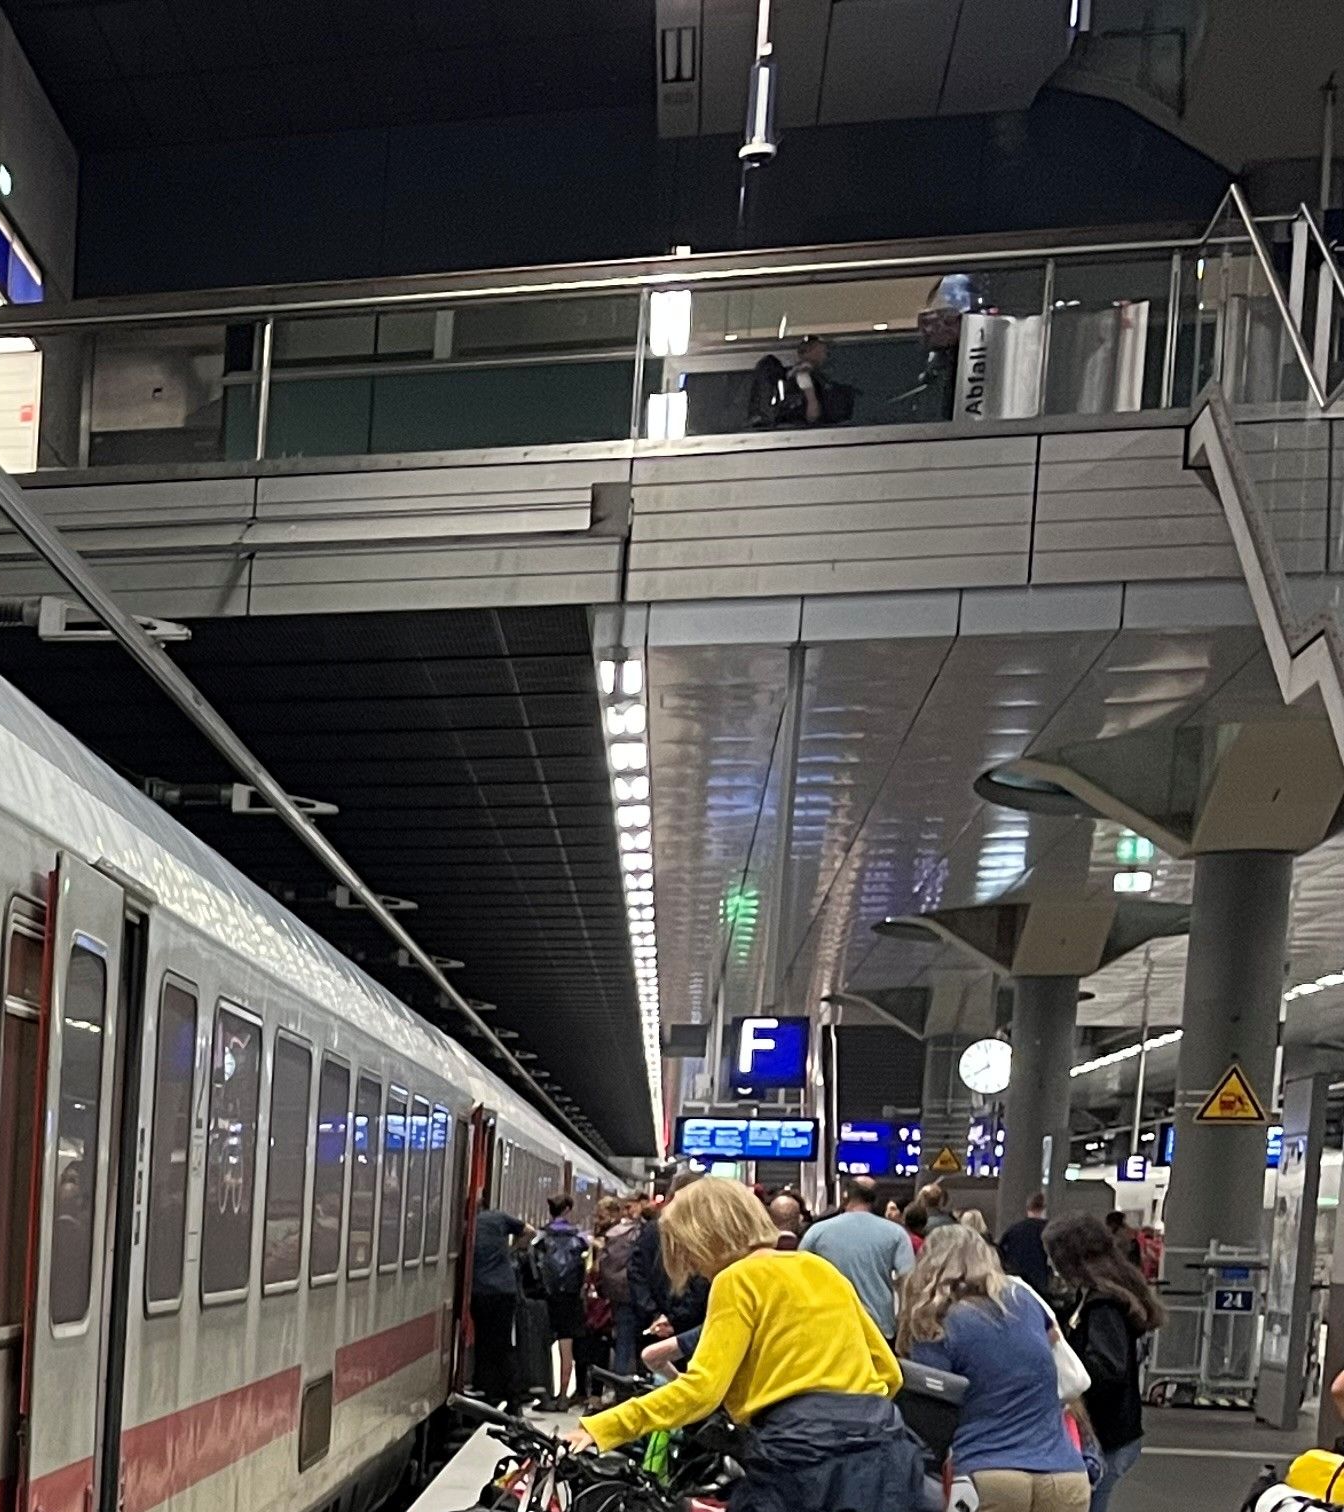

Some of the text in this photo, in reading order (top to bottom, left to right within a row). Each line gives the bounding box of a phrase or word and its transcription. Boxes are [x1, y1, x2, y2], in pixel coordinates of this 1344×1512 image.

[964, 346, 987, 416] Abfall
[739, 1018, 779, 1073] F
[1126, 1155, 1145, 1179] E
